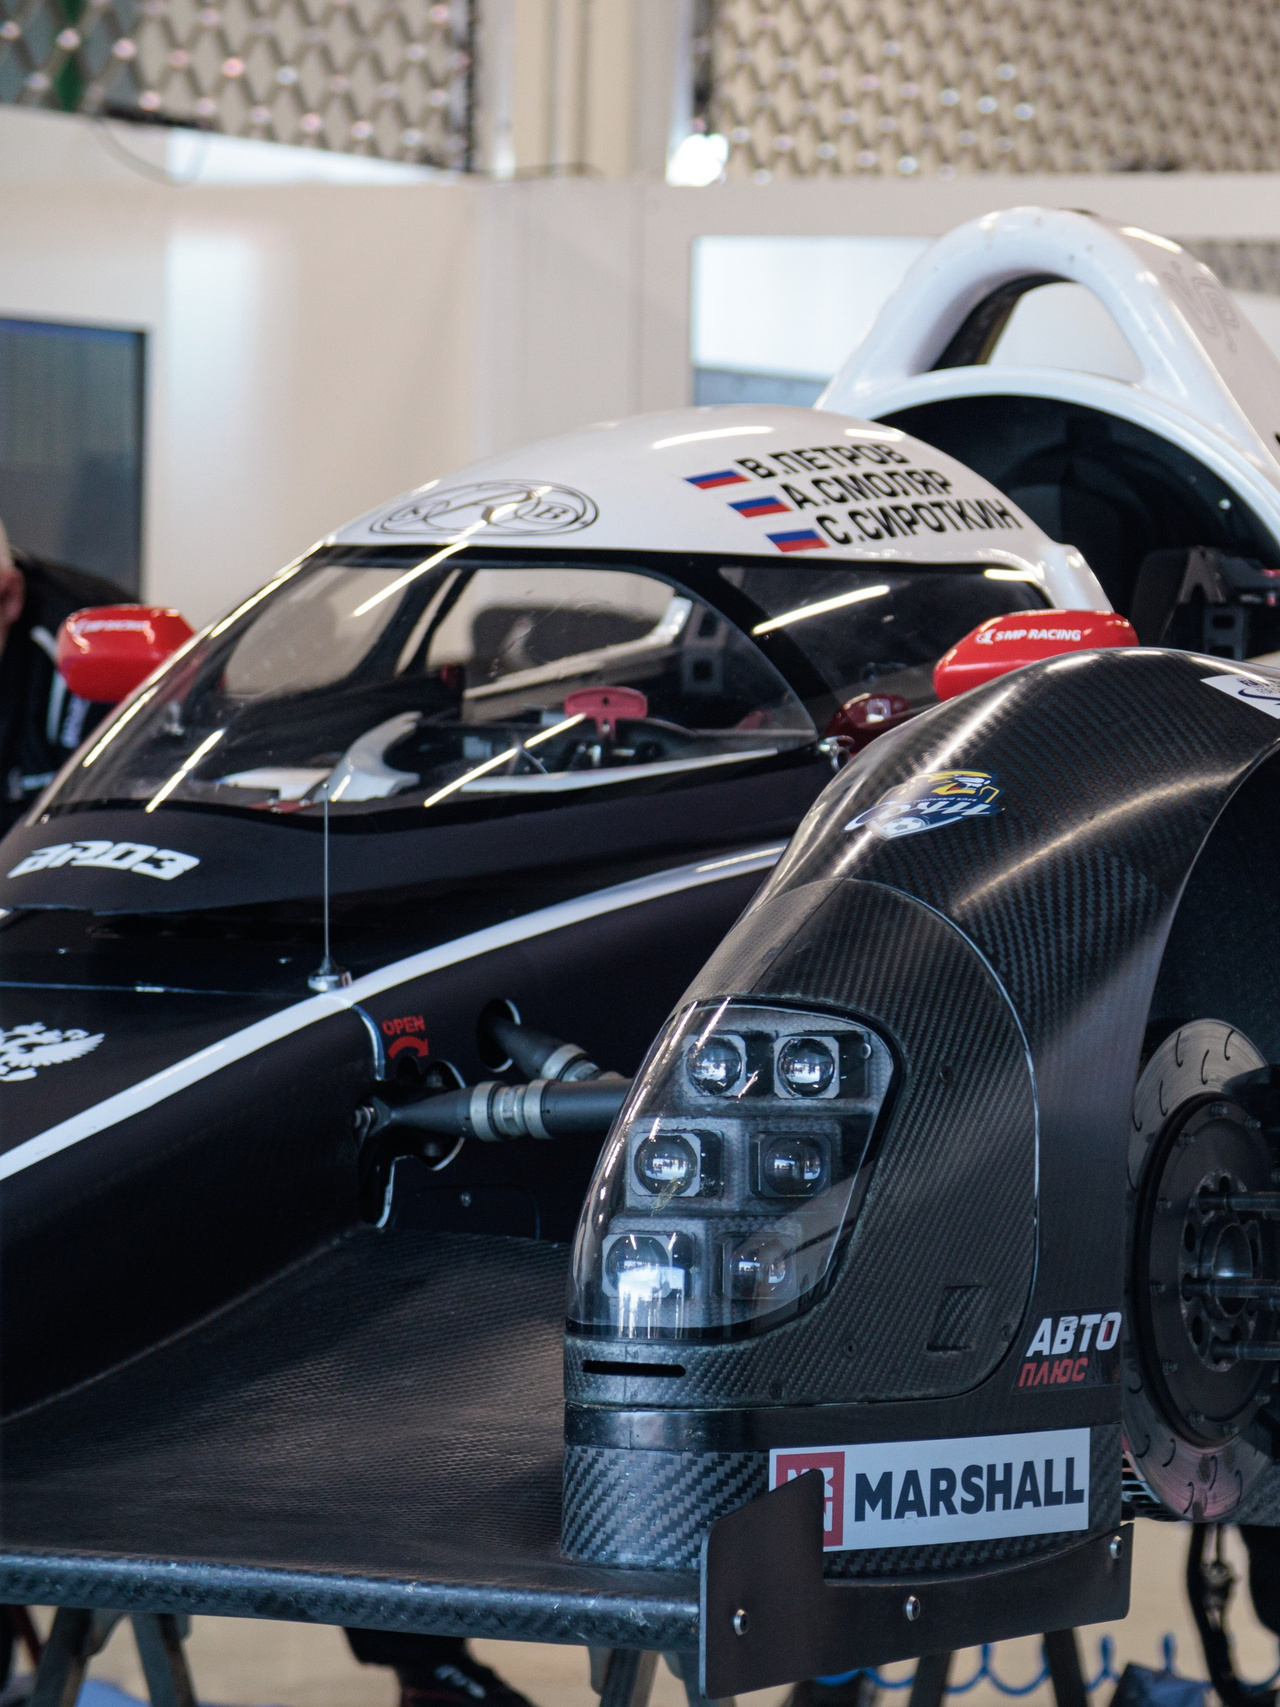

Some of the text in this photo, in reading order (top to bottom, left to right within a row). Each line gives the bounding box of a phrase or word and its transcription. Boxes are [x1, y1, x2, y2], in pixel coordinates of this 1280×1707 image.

[734, 443, 911, 479] В.ПЕТРОВ
[780, 469, 953, 510] А.СМОЛЯР
[815, 499, 1023, 546] С.СИРОТКИН
[994, 628, 1082, 641] SMP RACING
[382, 1015, 427, 1036] OPEN
[1025, 1311, 1123, 1358] АВТО
[1018, 1357, 1089, 1388] ПЛЮС
[854, 1456, 1085, 1523] MARSHALL
